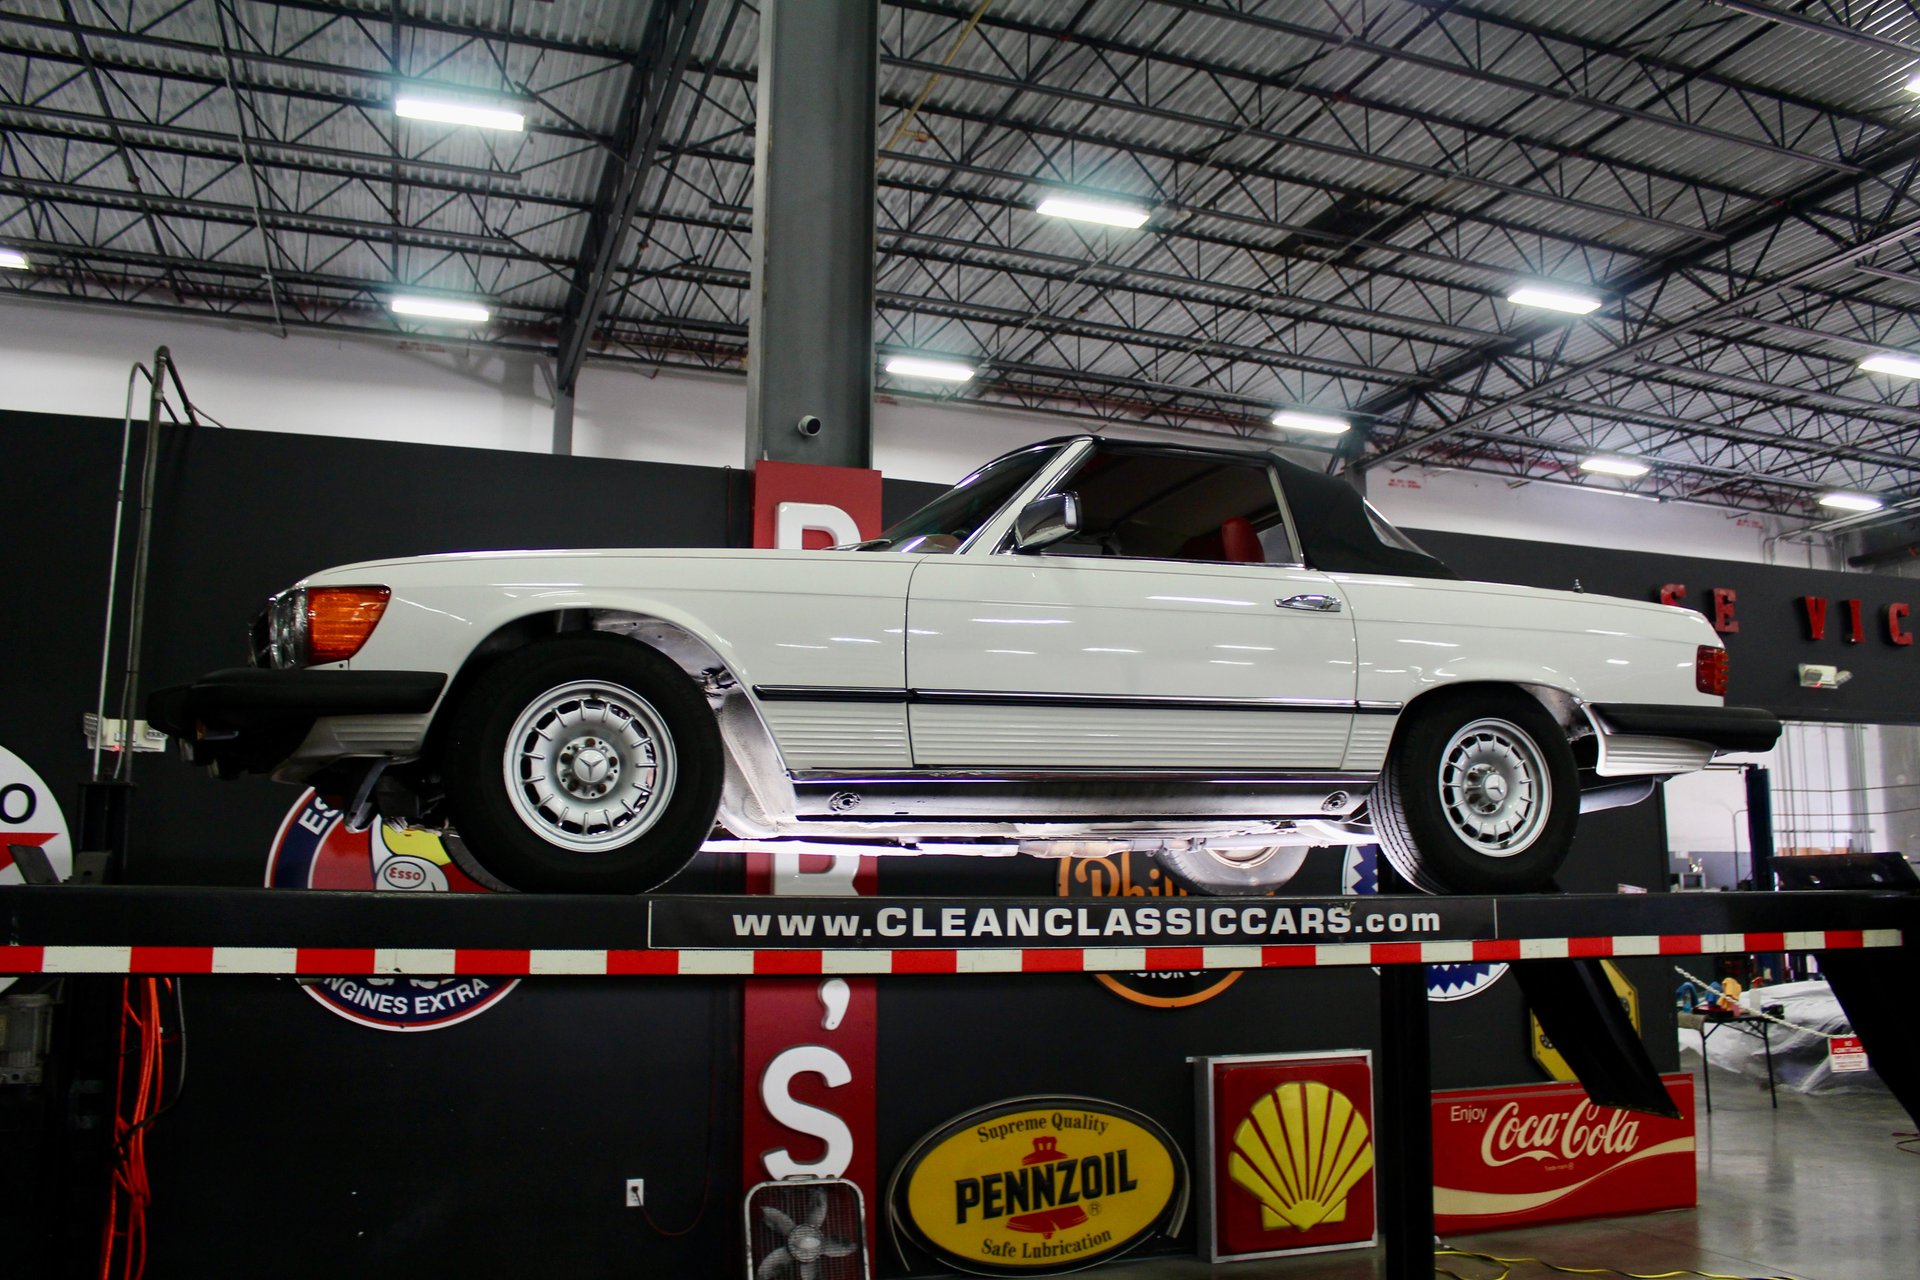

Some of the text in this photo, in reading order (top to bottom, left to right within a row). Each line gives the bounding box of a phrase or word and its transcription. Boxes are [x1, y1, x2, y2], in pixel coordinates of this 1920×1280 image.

[388, 866, 422, 881] Esso
[732, 907, 1441, 937] www.CLEANCLASSICCARS.com
[314, 977, 490, 1015] NGINES EXTRA
[976, 1112, 1109, 1143] Supreme Quality
[1451, 1104, 1488, 1123] Enjoy
[1481, 1097, 1641, 1167] Coca-Cola
[954, 1149, 1138, 1225] PENNZOIL
[981, 1230, 1113, 1259] Safe Lubrication
